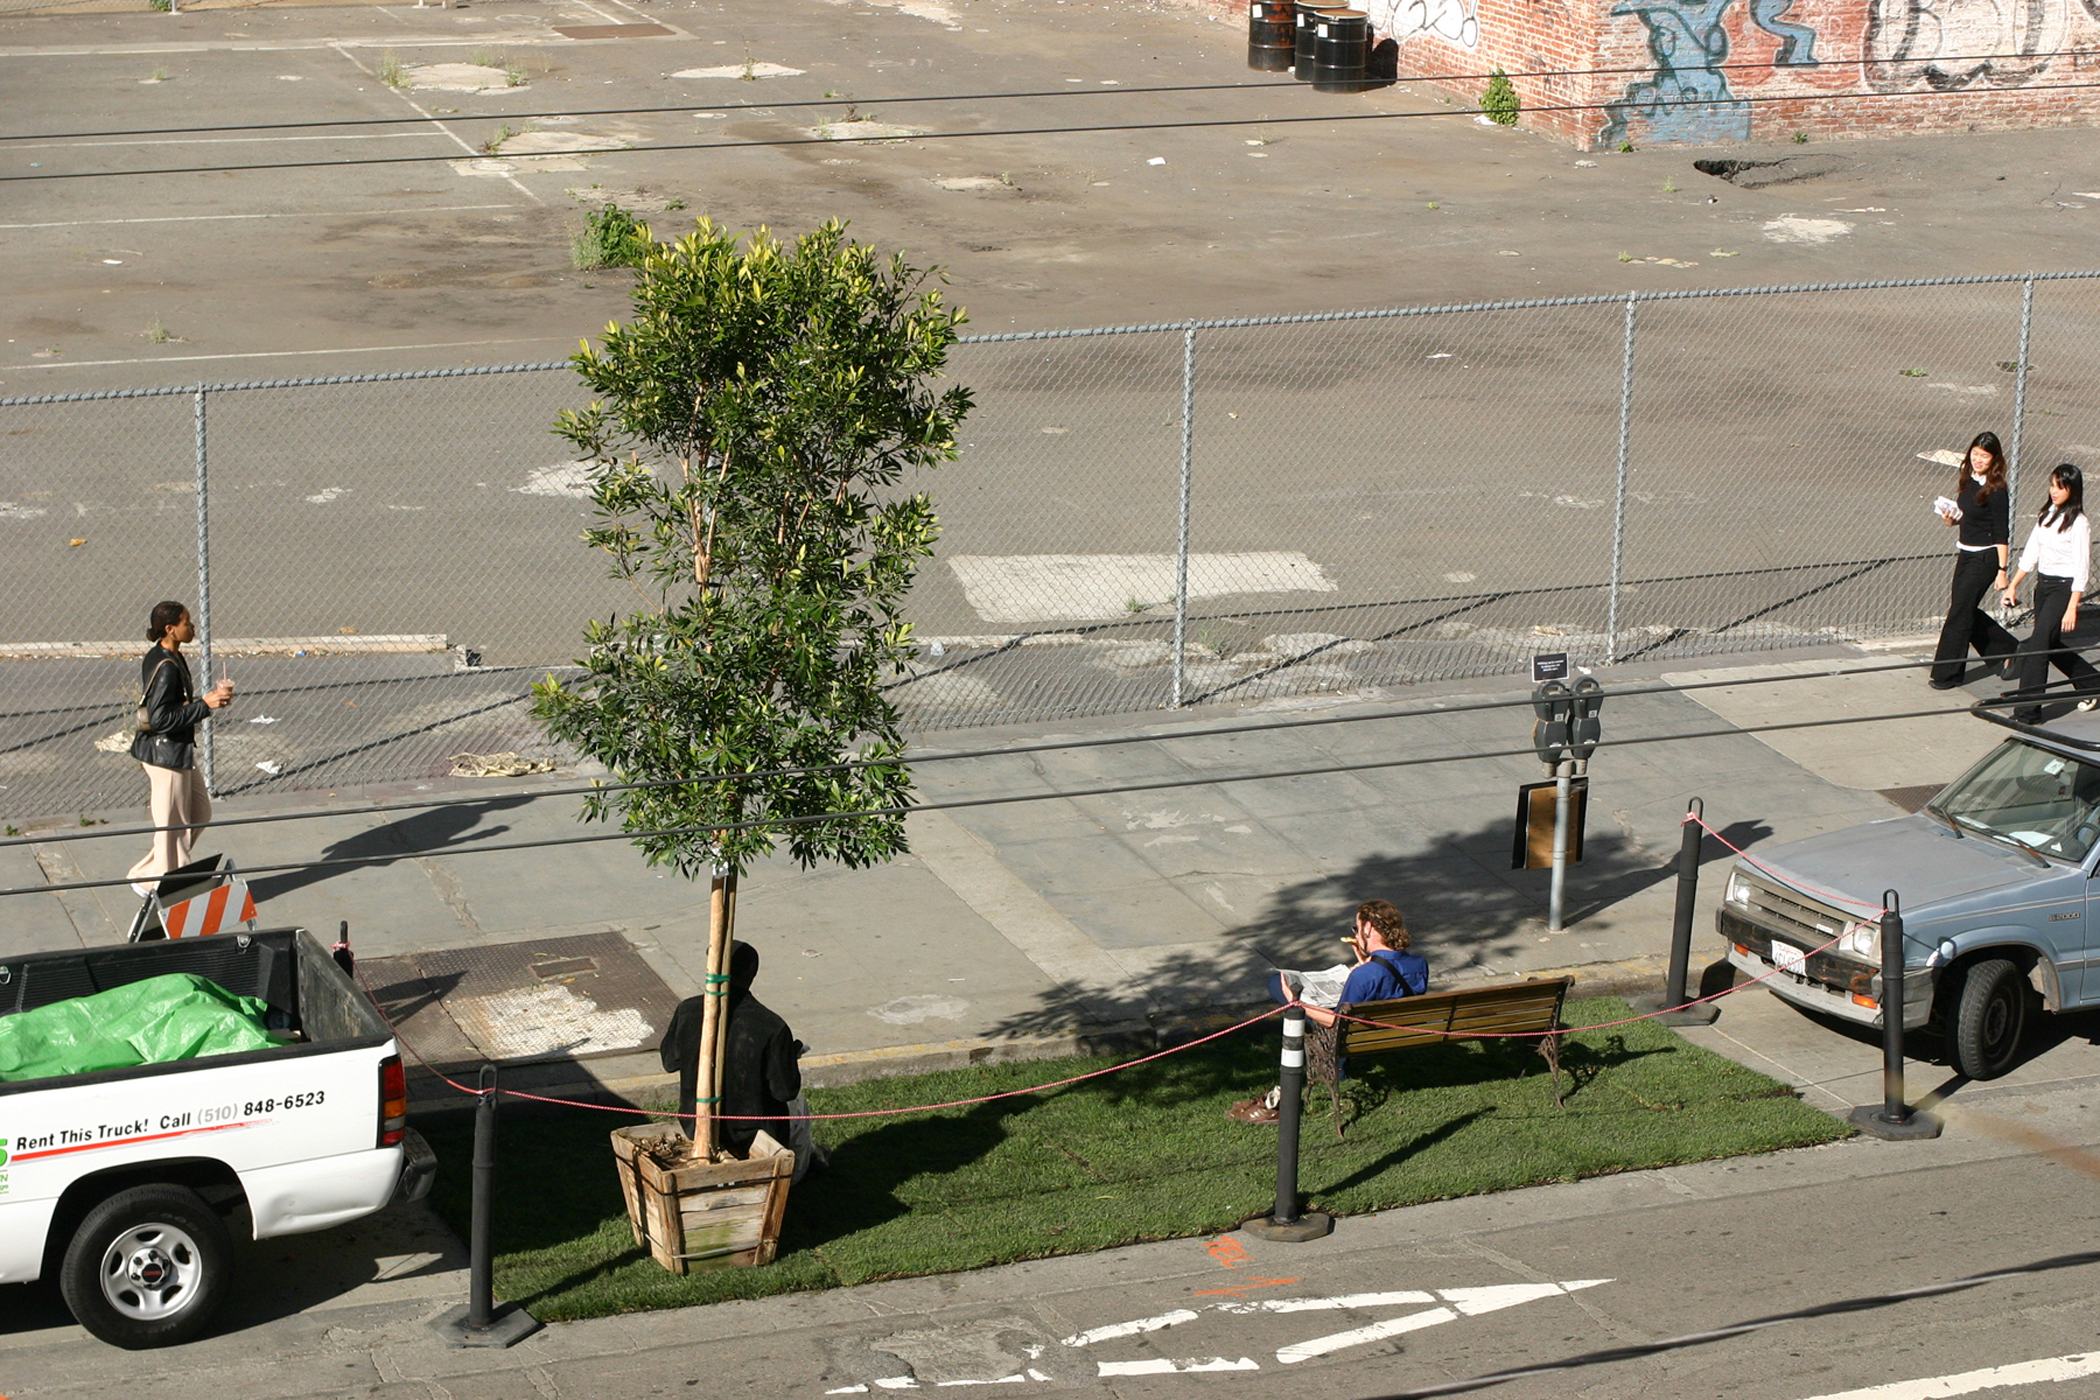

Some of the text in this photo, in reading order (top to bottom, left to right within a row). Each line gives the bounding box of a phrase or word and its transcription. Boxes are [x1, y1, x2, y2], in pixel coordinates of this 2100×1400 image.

[16, 1090, 325, 1151] Rent This Truck! Call (510) 848-6523
